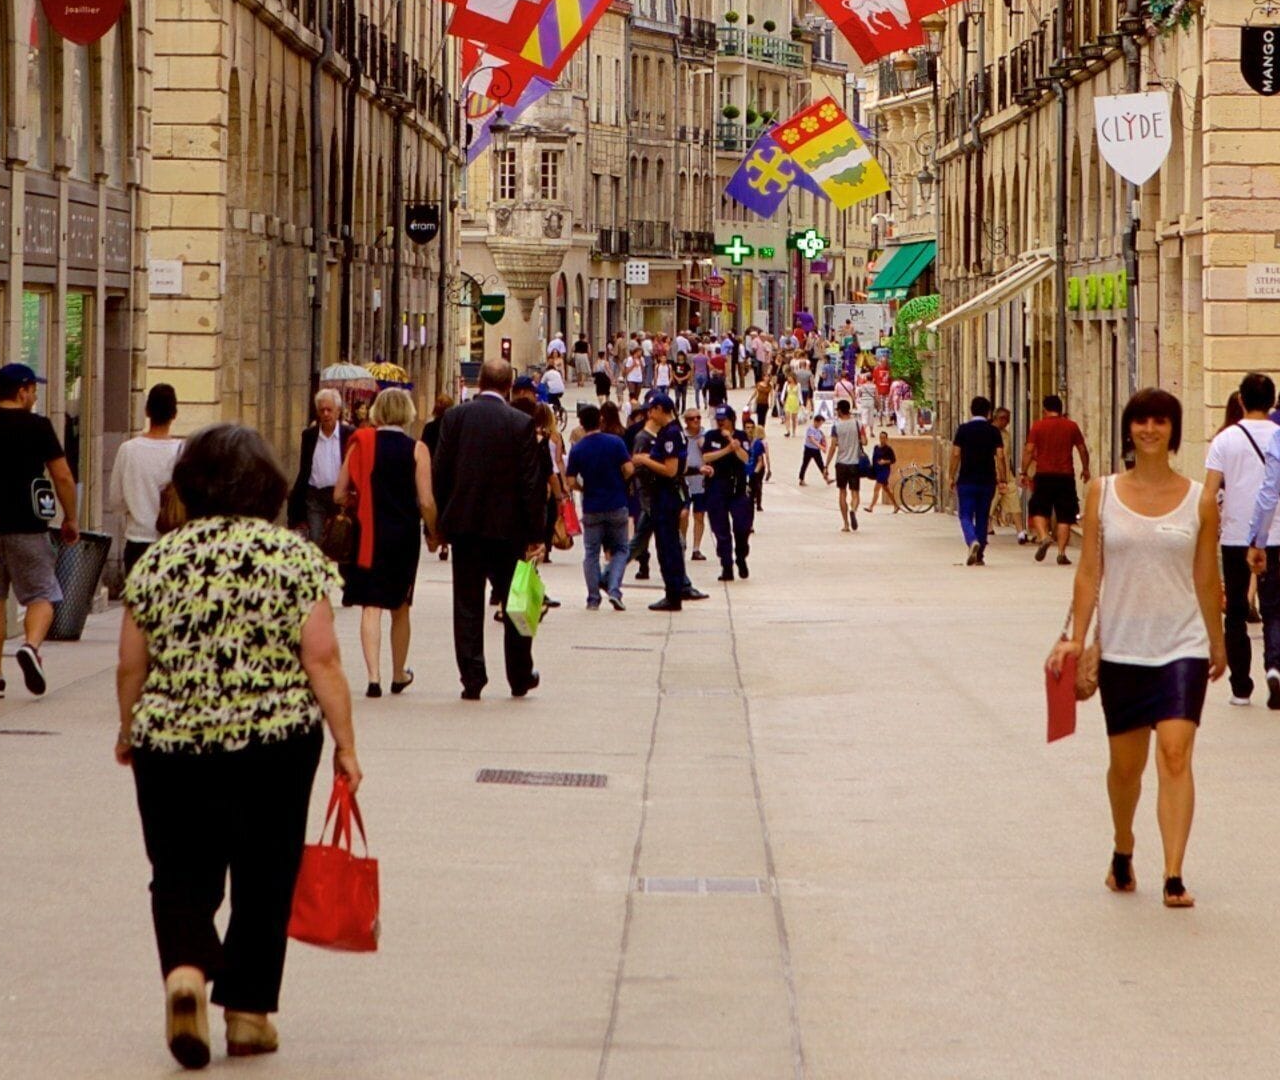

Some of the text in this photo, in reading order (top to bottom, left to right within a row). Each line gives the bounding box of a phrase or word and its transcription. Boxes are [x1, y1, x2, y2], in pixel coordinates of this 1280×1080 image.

[1262, 30, 1275, 93] MANGO
[1101, 111, 1164, 142] CLYDE
[1265, 266, 1280, 274] RUE
